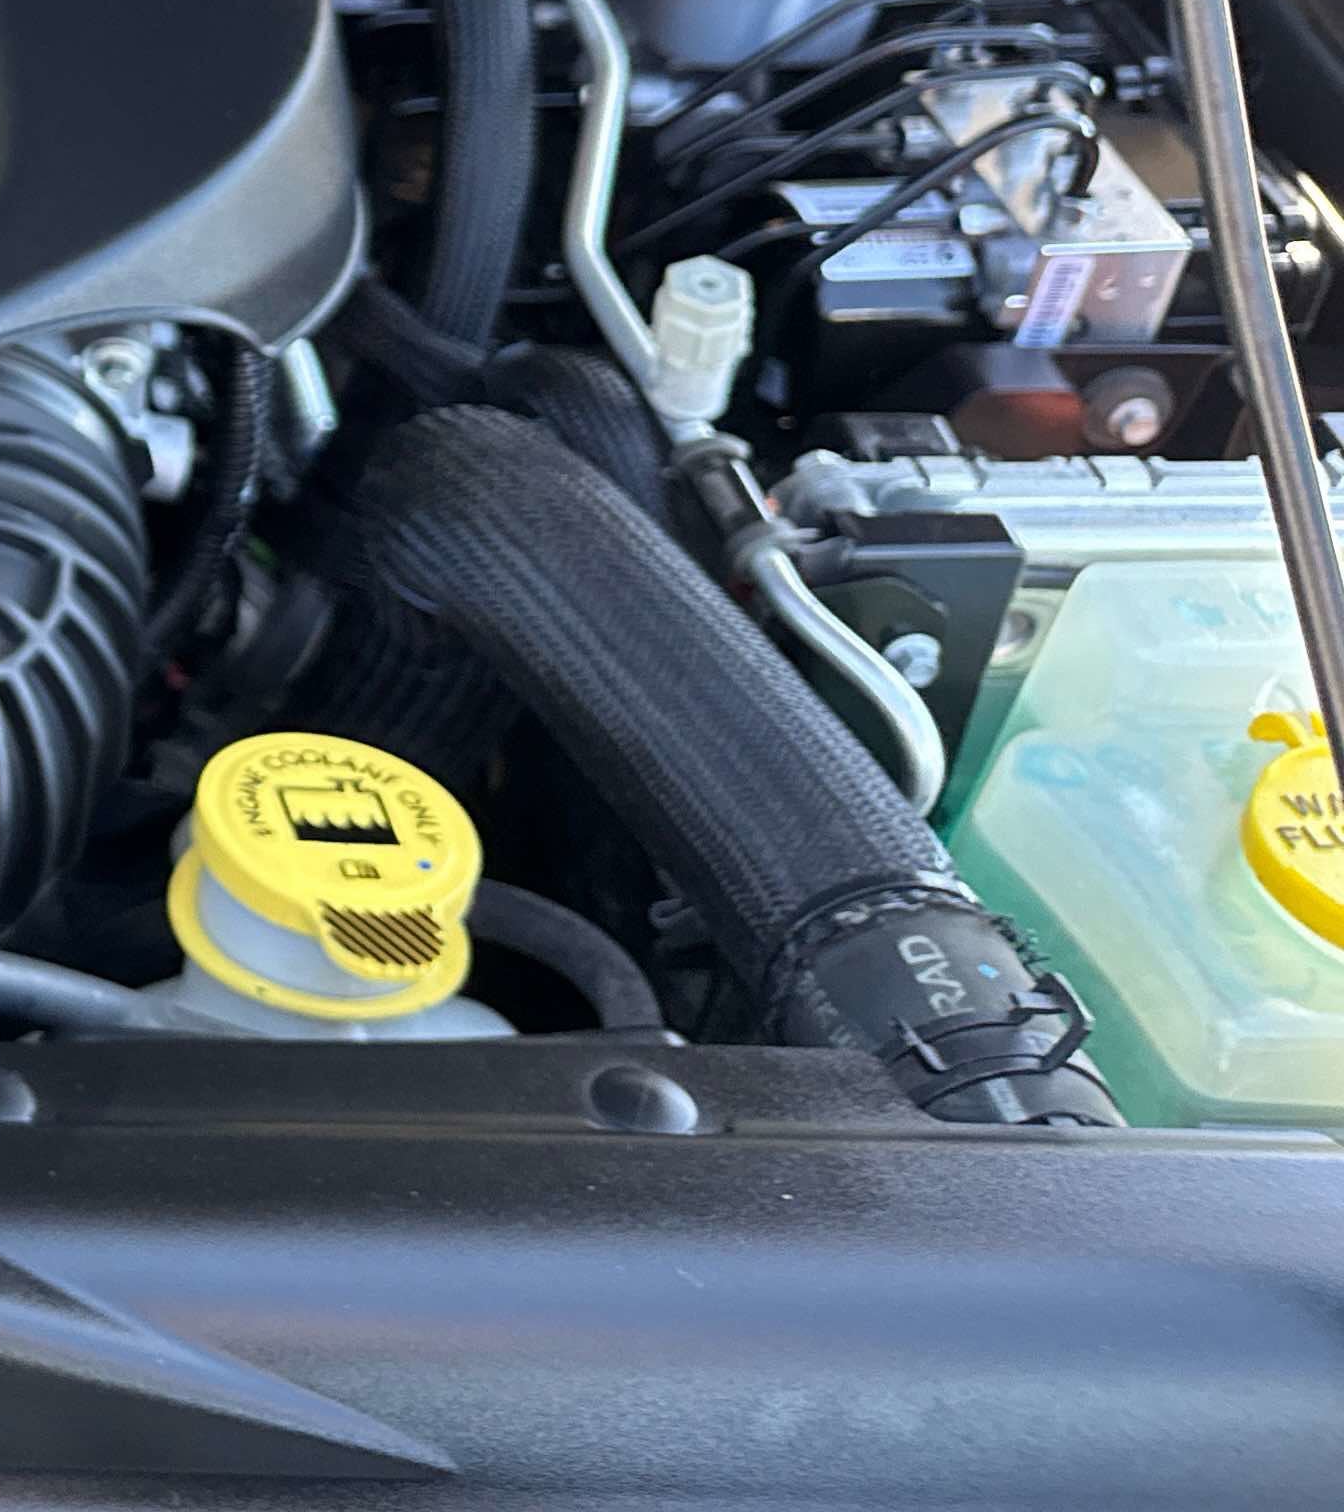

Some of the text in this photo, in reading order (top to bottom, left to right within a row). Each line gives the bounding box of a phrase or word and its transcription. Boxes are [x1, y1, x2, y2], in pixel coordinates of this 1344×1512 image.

[263, 749, 402, 784] COOLANT
[397, 790, 442, 846] ONLY
[897, 935, 975, 1020] RAD
